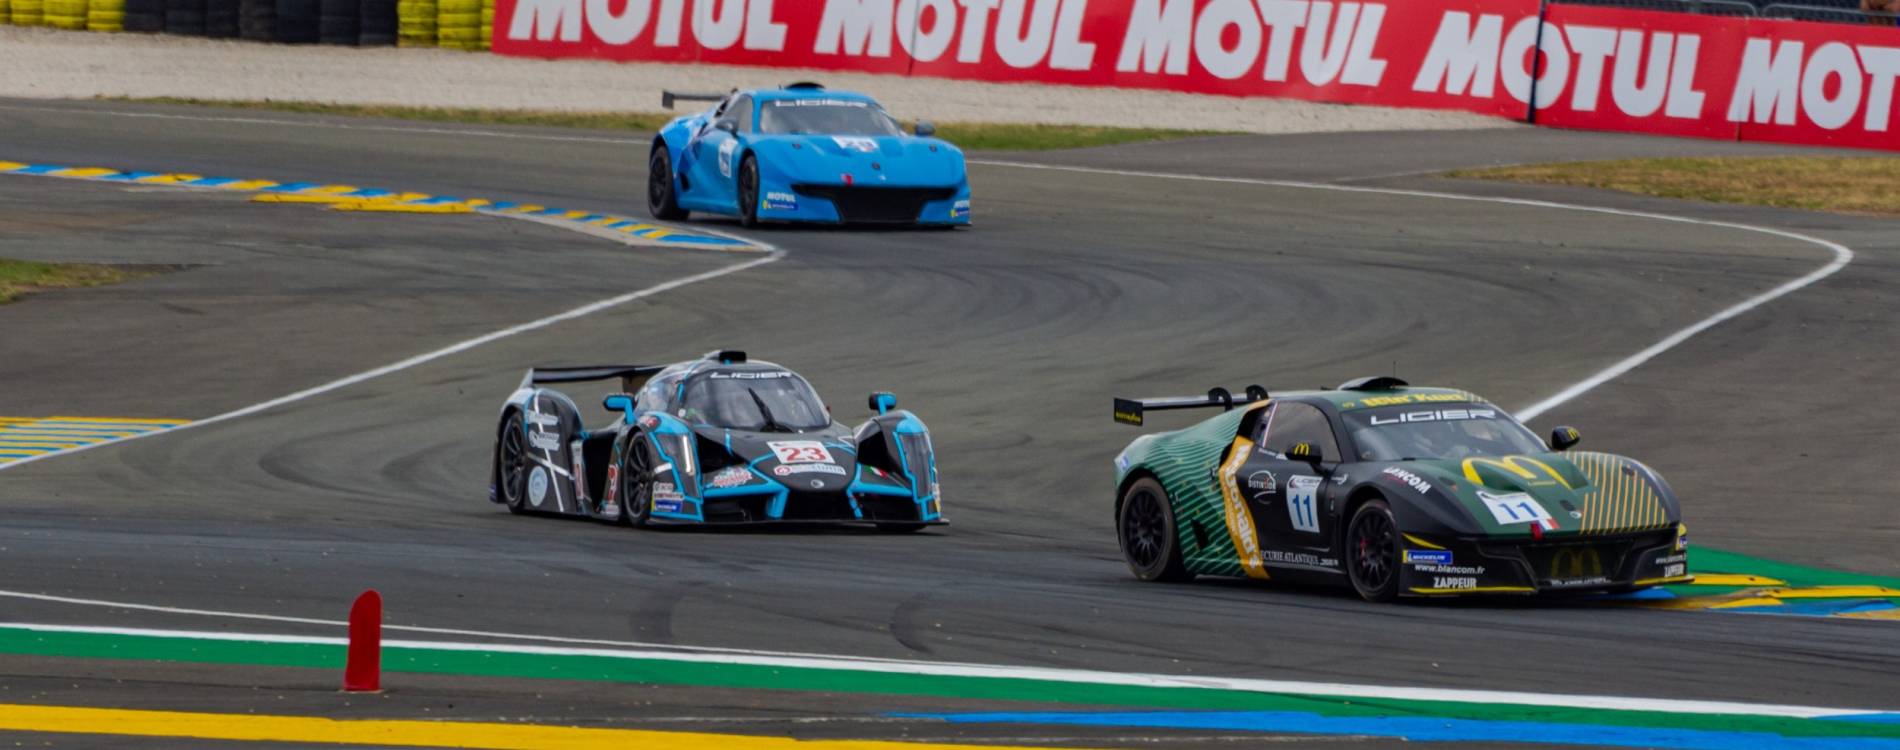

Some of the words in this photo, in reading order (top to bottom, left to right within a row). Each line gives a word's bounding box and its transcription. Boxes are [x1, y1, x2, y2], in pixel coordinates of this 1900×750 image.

[812, 0, 1097, 71] MOTUL
[1115, 0, 1388, 87] MOTUL
[1411, 10, 1706, 119] MOTUL
[1725, 36, 1900, 133] MOT
[709, 371, 792, 379] LIGIER
[1370, 409, 1496, 426] LIGIER
[780, 446, 827, 463] 23
[1293, 494, 1314, 528] 11
[1499, 501, 1539, 520] 11
[1433, 577, 1477, 590] ZAPPEUR
